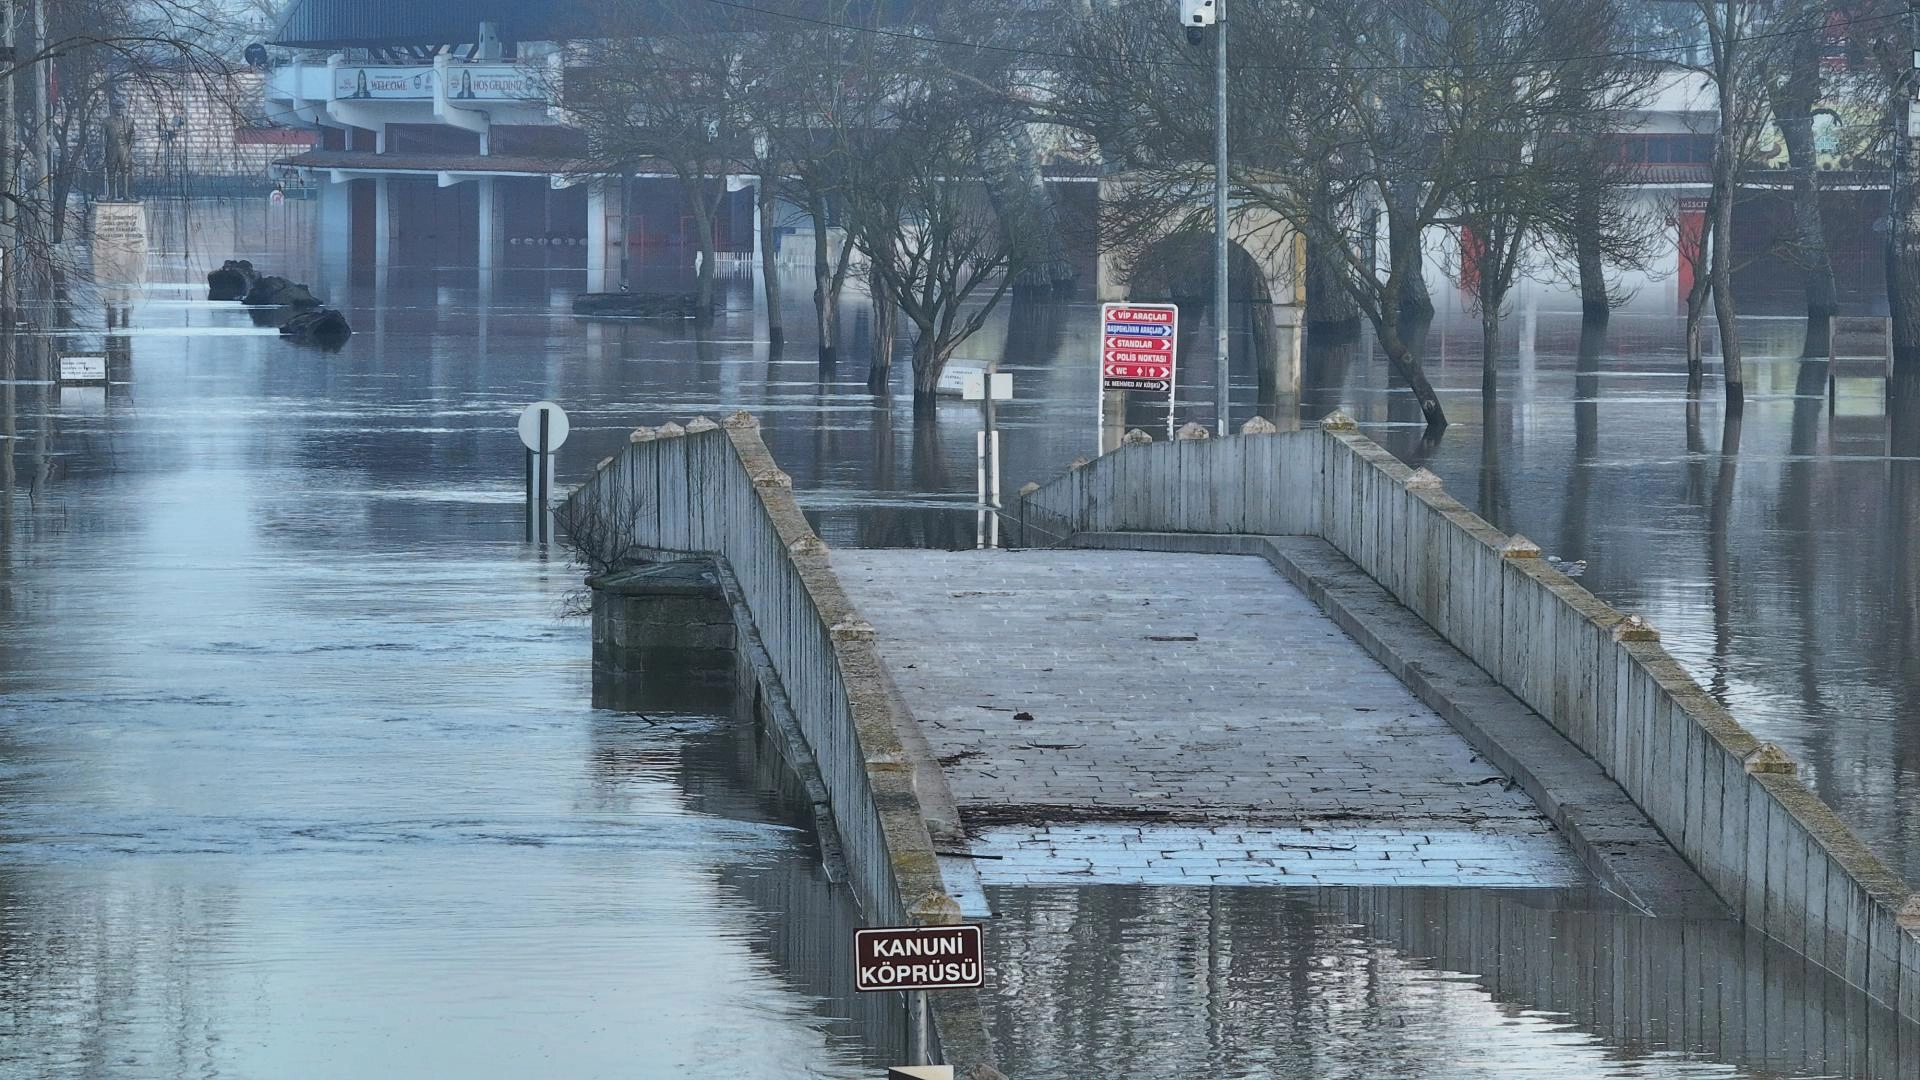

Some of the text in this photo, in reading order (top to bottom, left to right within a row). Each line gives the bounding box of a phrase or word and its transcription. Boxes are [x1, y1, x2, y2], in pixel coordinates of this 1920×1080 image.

[371, 80, 407, 91] WELCOME
[474, 80, 488, 92] HOŞ
[1118, 311, 1167, 321] VİP ARAÇLAR
[1117, 340, 1153, 348] STANDLAR
[1116, 353, 1167, 362] POLİS NOKTASI
[1116, 367, 1127, 375] WC
[1143, 381, 1160, 390] KÖŞKÜ
[873, 932, 963, 957] KANUNİ
[861, 958, 977, 984] KÖPRÜSÜ
